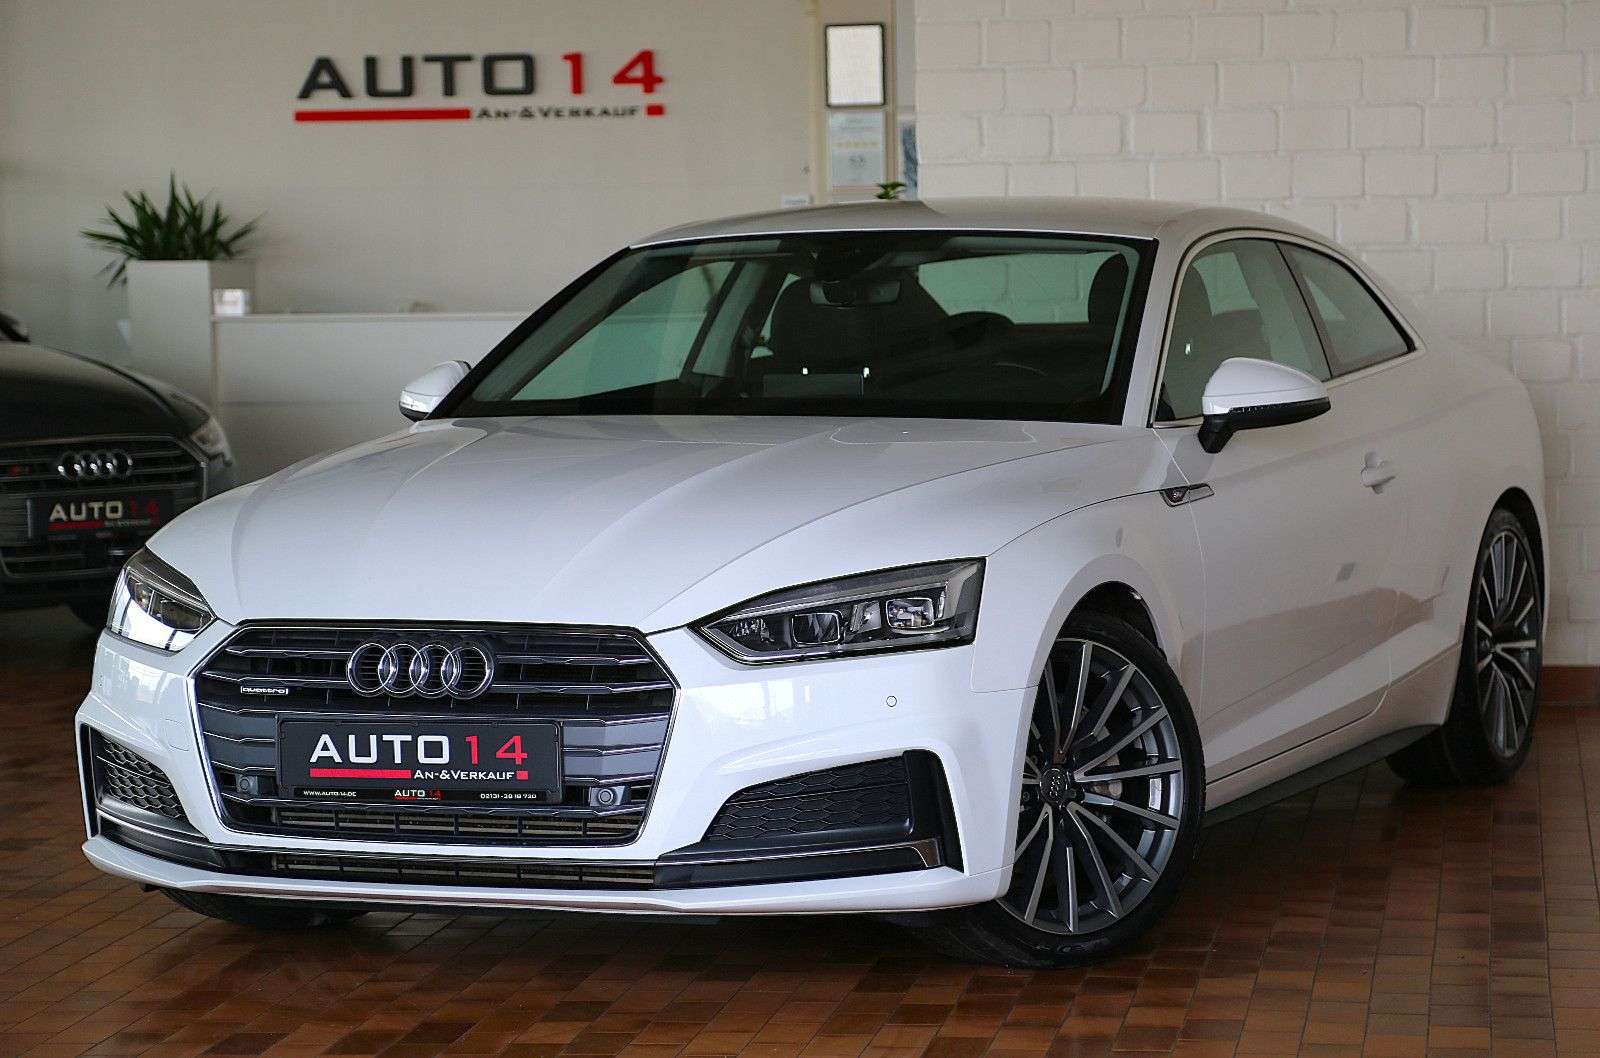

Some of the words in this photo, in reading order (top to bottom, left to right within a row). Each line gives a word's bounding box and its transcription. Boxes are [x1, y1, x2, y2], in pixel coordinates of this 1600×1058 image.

[296, 53, 538, 101] AUTO
[560, 49, 665, 96] 14
[49, 501, 123, 521] AUTO
[241, 687, 287, 695] quattro
[309, 733, 450, 766] AUTO
[466, 735, 529, 766] 14
[394, 789, 427, 798] AUTO
